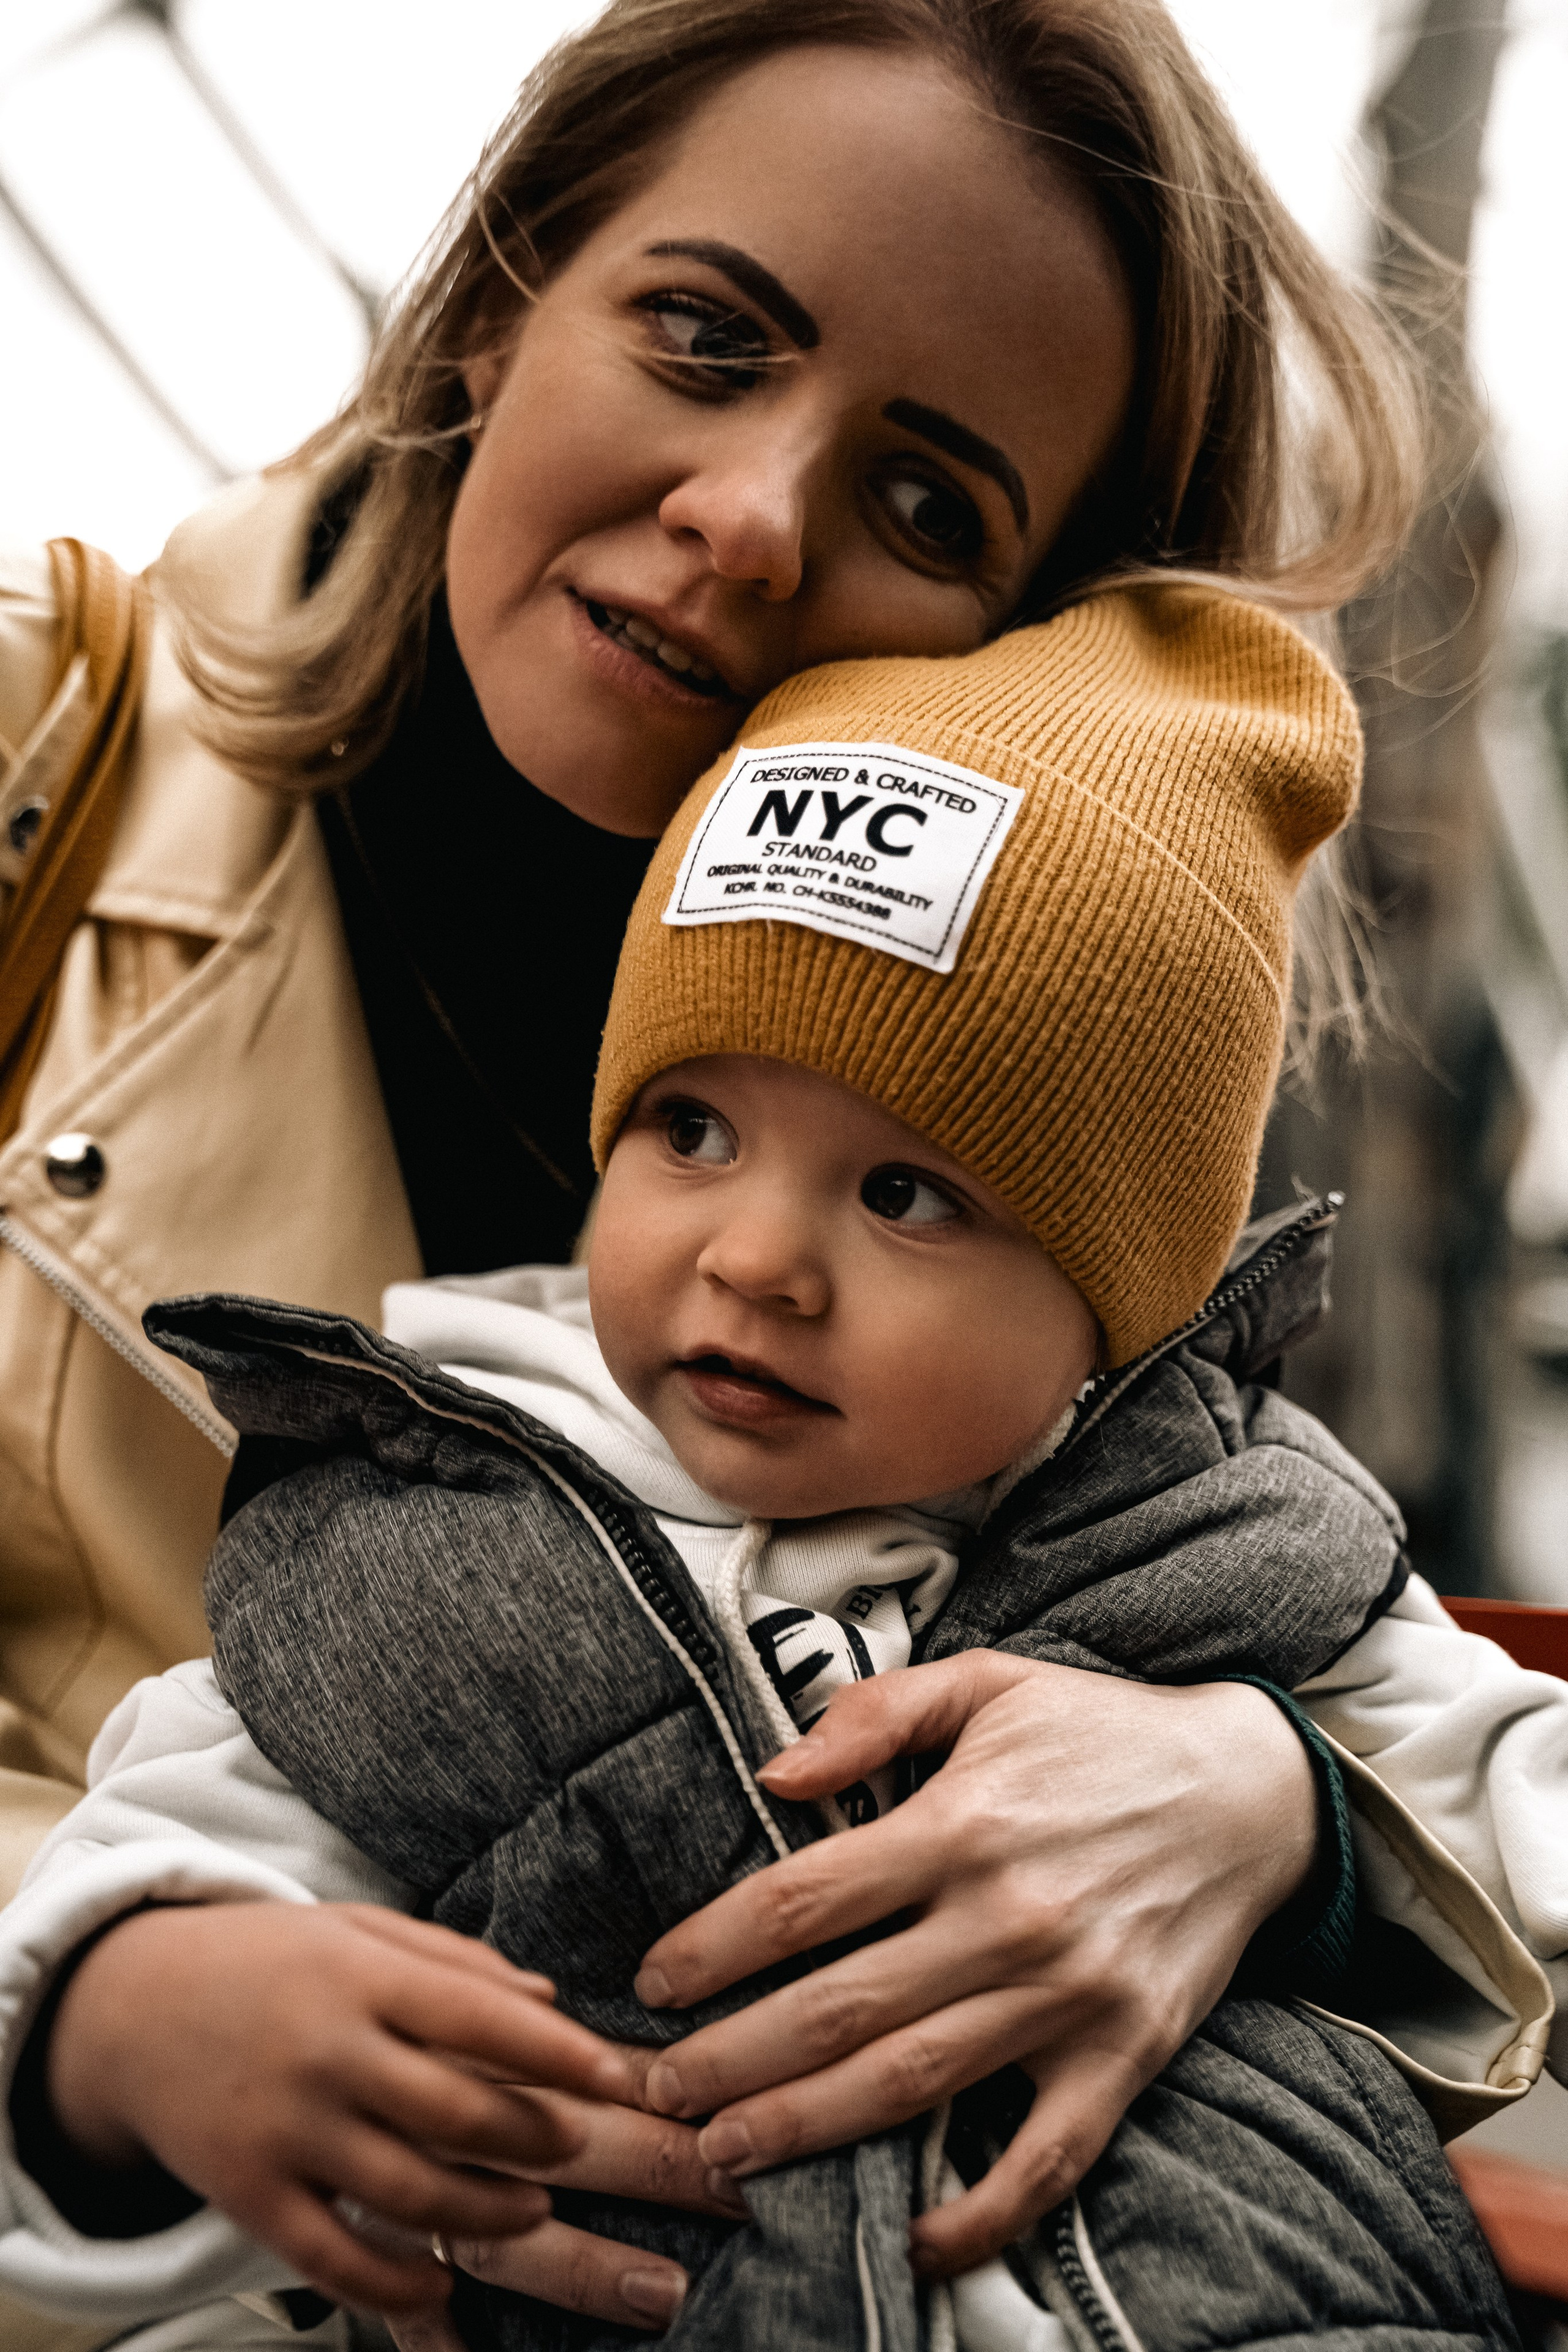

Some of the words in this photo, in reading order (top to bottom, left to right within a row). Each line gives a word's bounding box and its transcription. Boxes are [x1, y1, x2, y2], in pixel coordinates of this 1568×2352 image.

[750, 766, 850, 783] DESIGNED
[854, 768, 869, 785] &
[876, 773, 977, 814] CRAFTED
[746, 789, 929, 858] NYC
[761, 841, 878, 873] STANDARD
[707, 864, 763, 877] ORIGINAL
[767, 864, 827, 880] QUALITY
[844, 876, 933, 911] DURABILITY
